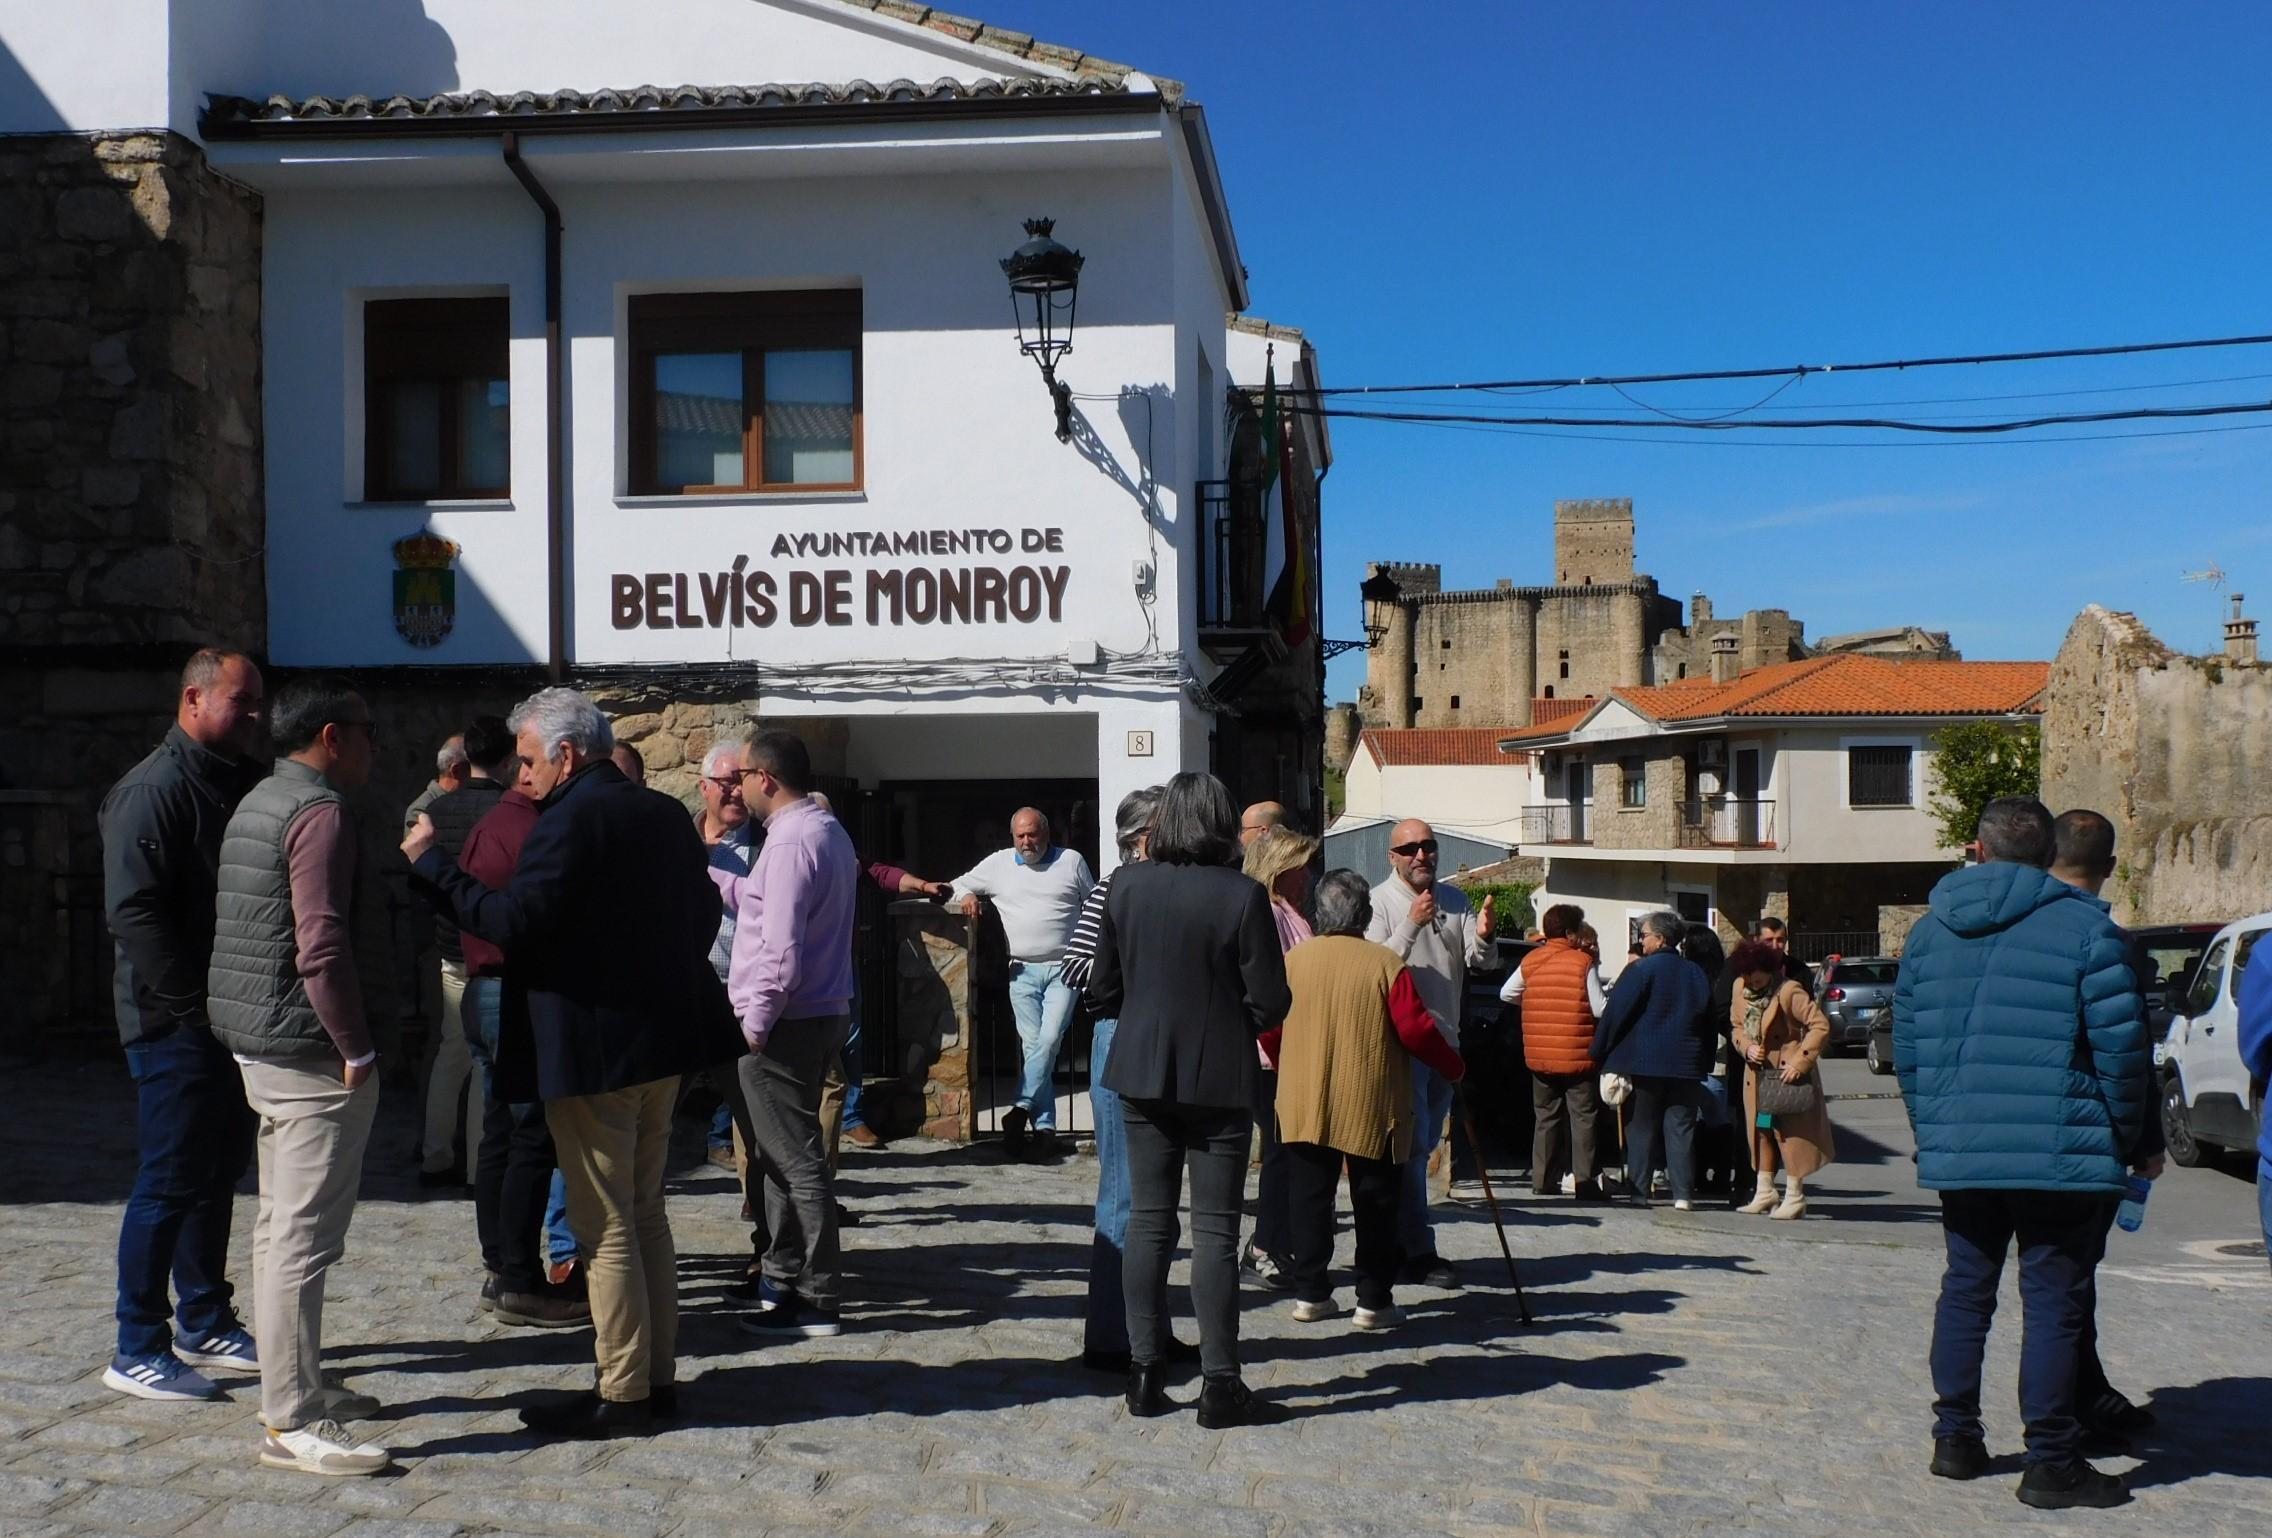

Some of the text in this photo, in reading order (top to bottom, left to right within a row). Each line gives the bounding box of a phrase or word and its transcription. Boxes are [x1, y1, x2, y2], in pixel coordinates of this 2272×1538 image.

[771, 528, 1064, 558] AYUNTAMIENTO DE
[611, 554, 1071, 630] BELVÍS DE MONROY
[1135, 735, 1145, 752] 8
